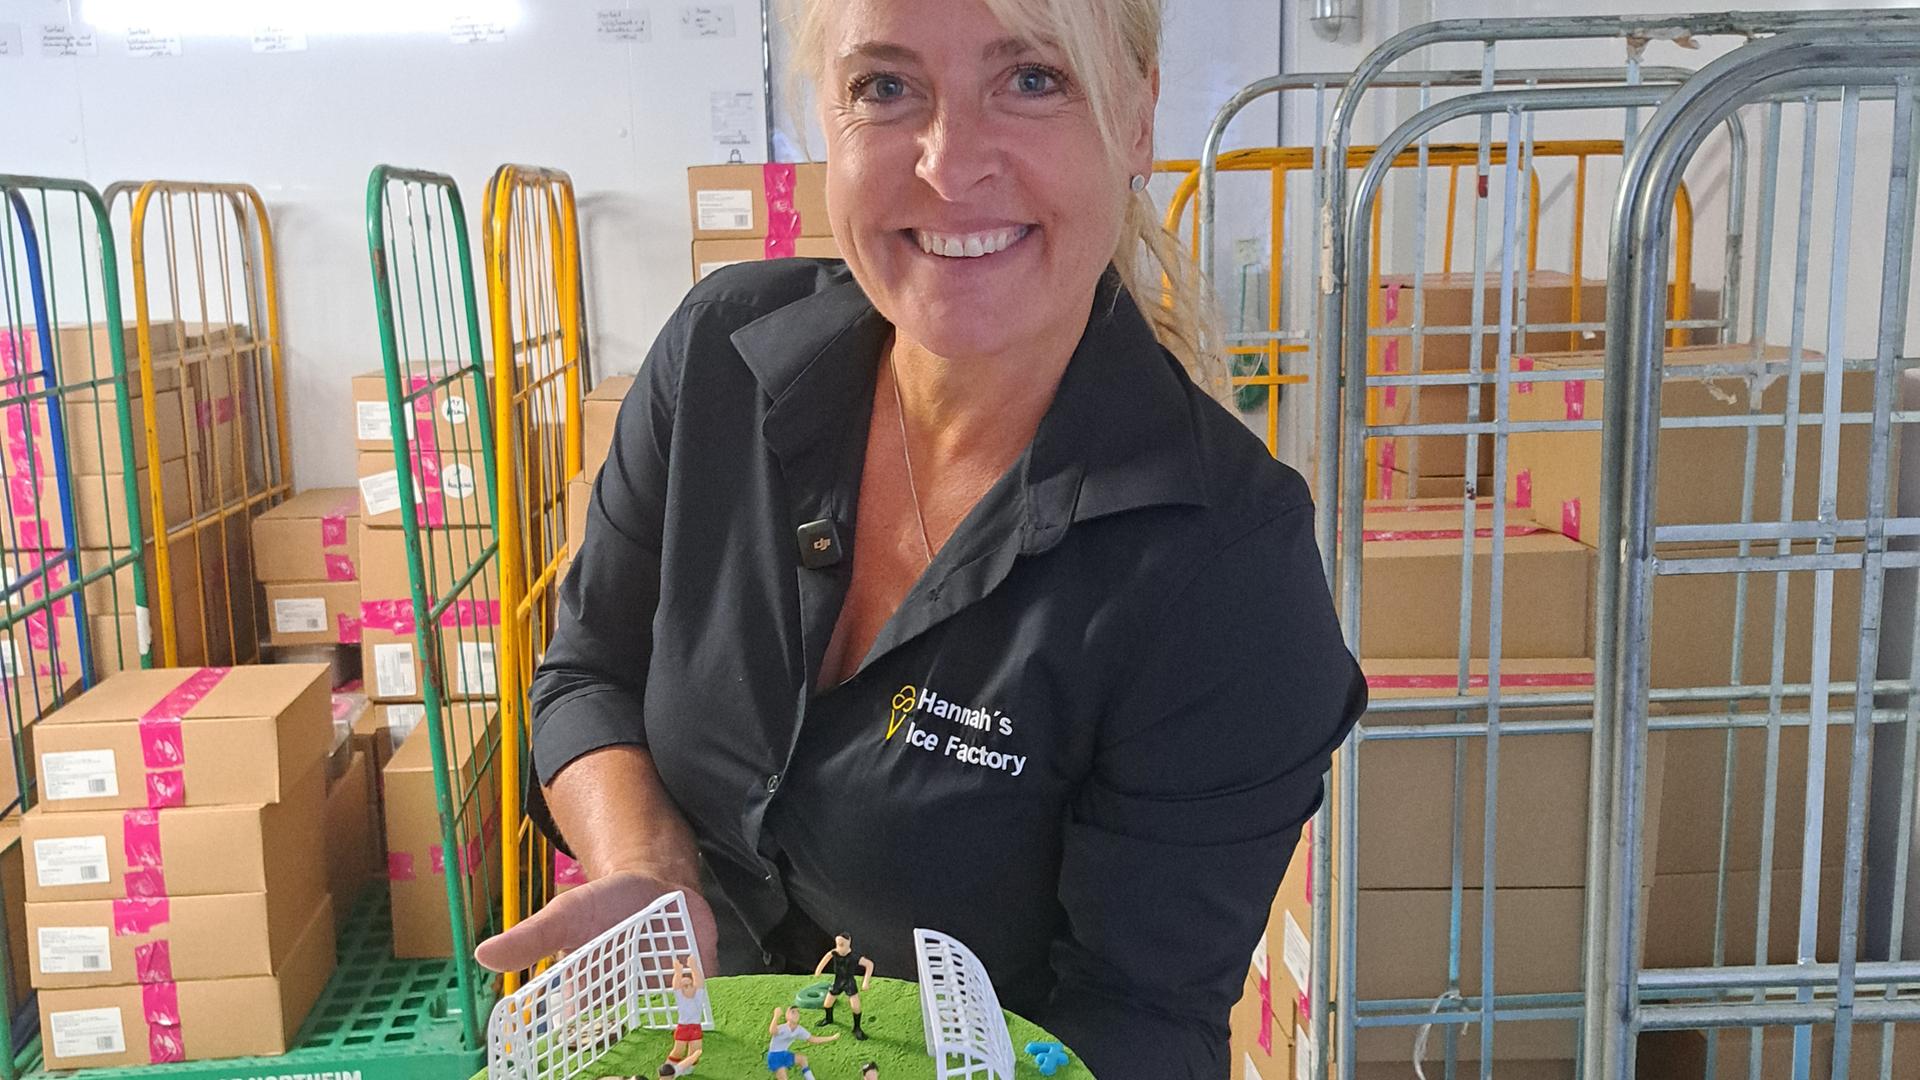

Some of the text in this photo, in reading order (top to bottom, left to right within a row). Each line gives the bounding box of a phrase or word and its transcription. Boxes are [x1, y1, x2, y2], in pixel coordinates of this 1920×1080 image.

[905, 721, 1027, 776] Ice Factory
[248, 1070, 362, 1080] HEIM
